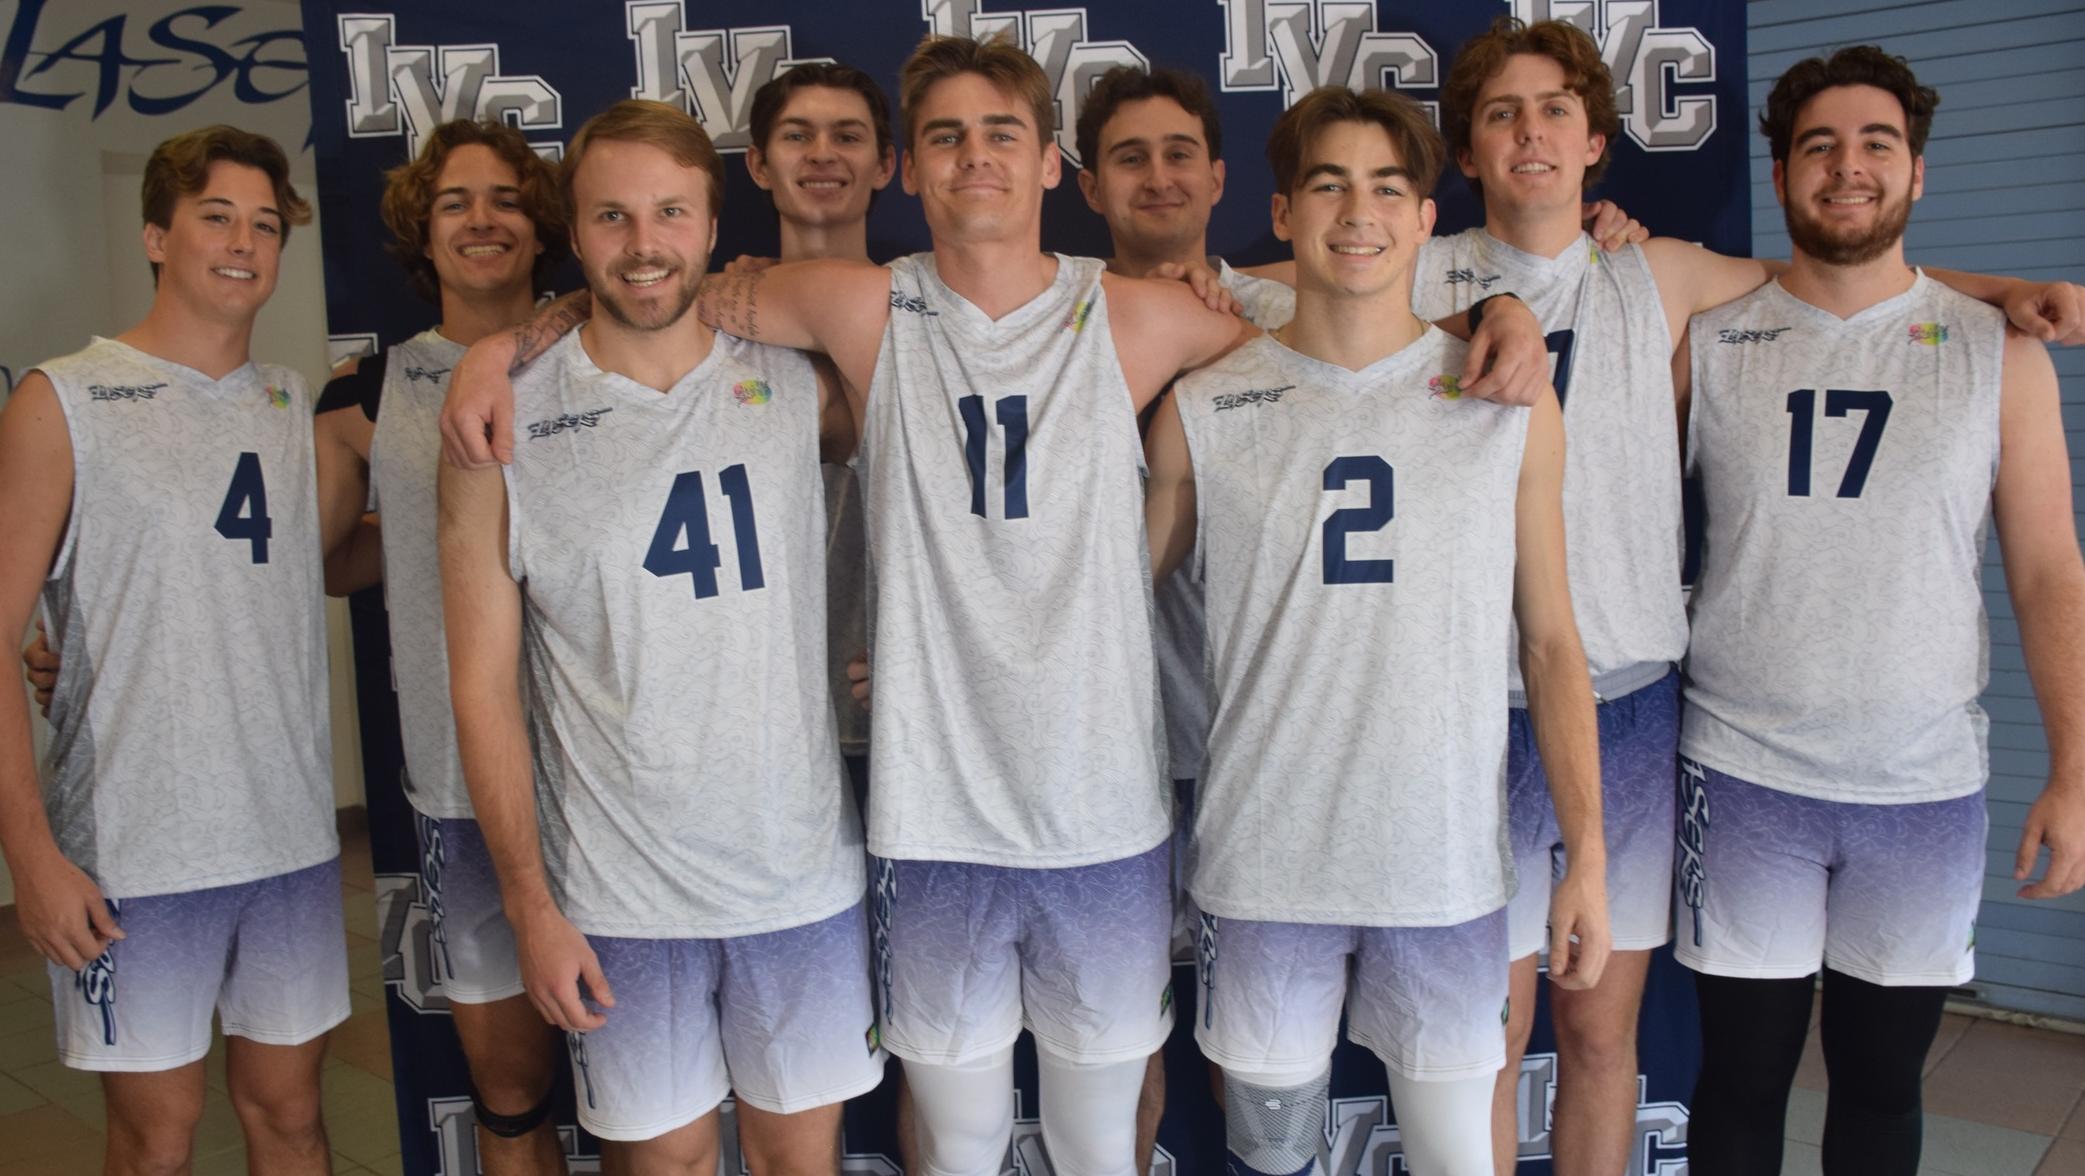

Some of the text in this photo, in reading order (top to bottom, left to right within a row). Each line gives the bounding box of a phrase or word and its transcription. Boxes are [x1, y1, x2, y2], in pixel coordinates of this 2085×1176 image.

[626, 0, 836, 154] IV
[959, 395, 1028, 519] 11
[1786, 388, 1893, 498] 17
[214, 452, 271, 564] 4
[642, 463, 765, 599] 41
[1322, 455, 1393, 584] 2
